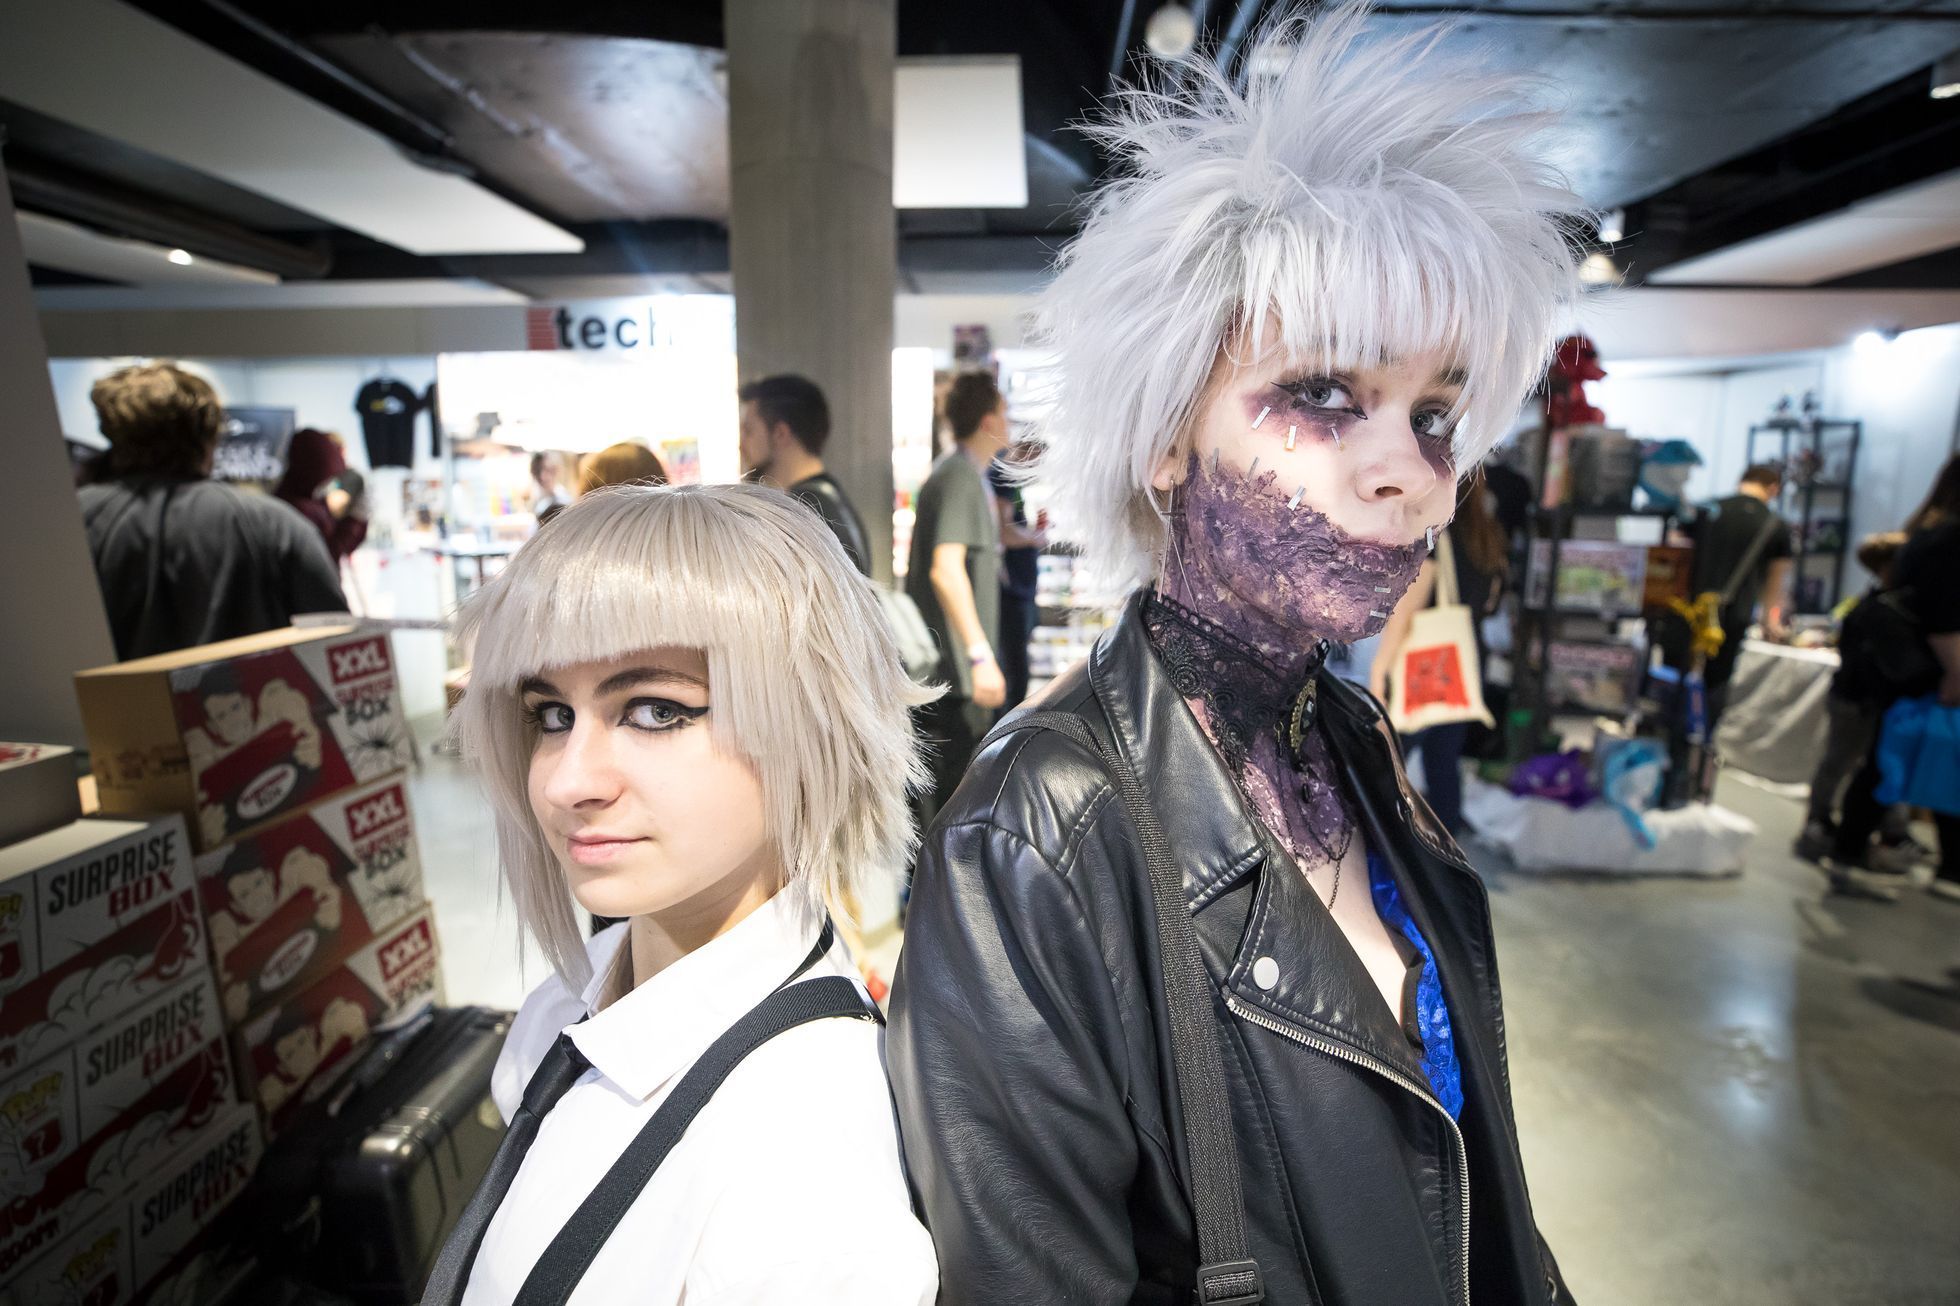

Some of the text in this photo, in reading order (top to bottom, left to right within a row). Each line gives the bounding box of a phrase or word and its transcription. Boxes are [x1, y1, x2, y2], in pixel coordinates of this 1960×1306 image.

[332, 640, 386, 678] XXL
[346, 696, 390, 727] BOX
[351, 788, 403, 838] XXL
[48, 829, 176, 914] SURPRISE
[364, 845, 406, 880] BOX
[107, 867, 176, 918] BOX
[383, 924, 429, 976] XXL
[86, 982, 206, 1087] SURPRISE
[142, 1019, 204, 1079] BOX
[141, 1120, 251, 1238] SURPRISE
